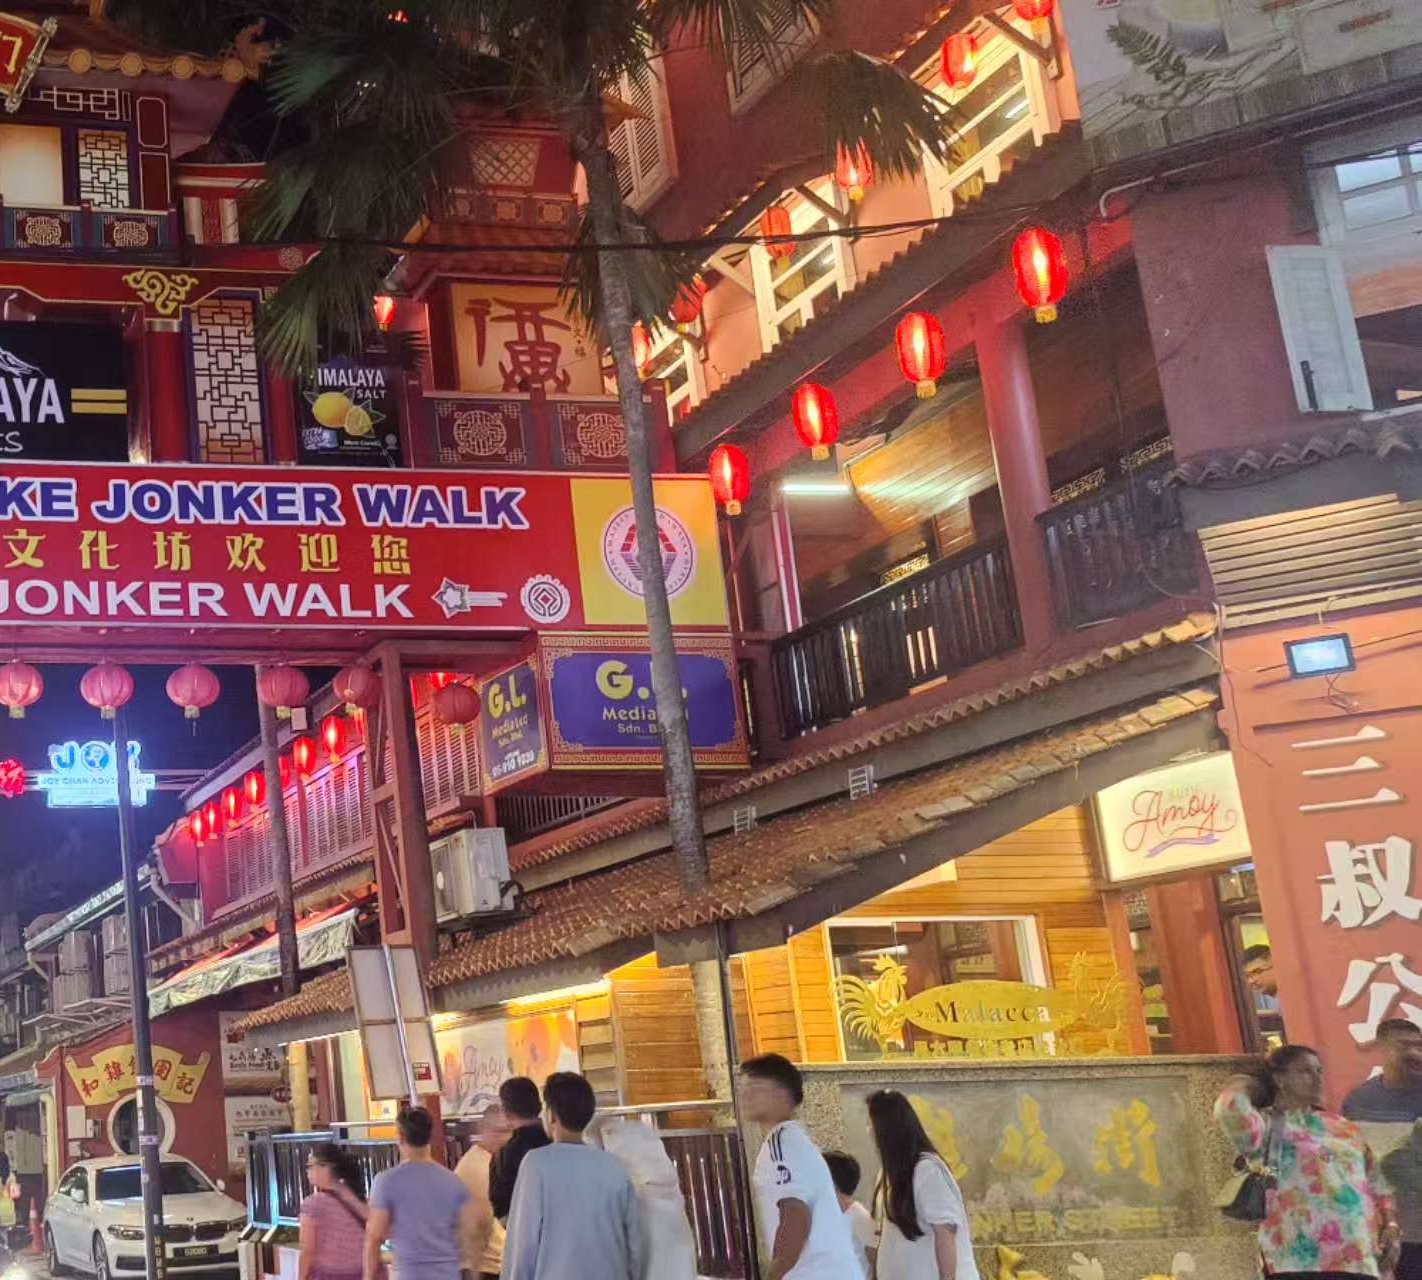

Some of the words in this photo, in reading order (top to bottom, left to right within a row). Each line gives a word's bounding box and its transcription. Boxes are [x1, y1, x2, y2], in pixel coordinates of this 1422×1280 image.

[318, 368, 385, 387] IMALAYA
[357, 388, 386, 399] SALT
[92, 477, 342, 527] JONKER
[356, 483, 529, 530] WALK
[242, 582, 414, 619] WALK
[488, 674, 527, 719] G.L.
[595, 659, 688, 700] G..
[1123, 790, 1223, 852] Amoy
[1291, 725, 1422, 1082] 三叔公
[935, 1000, 1051, 1024] Malacca
